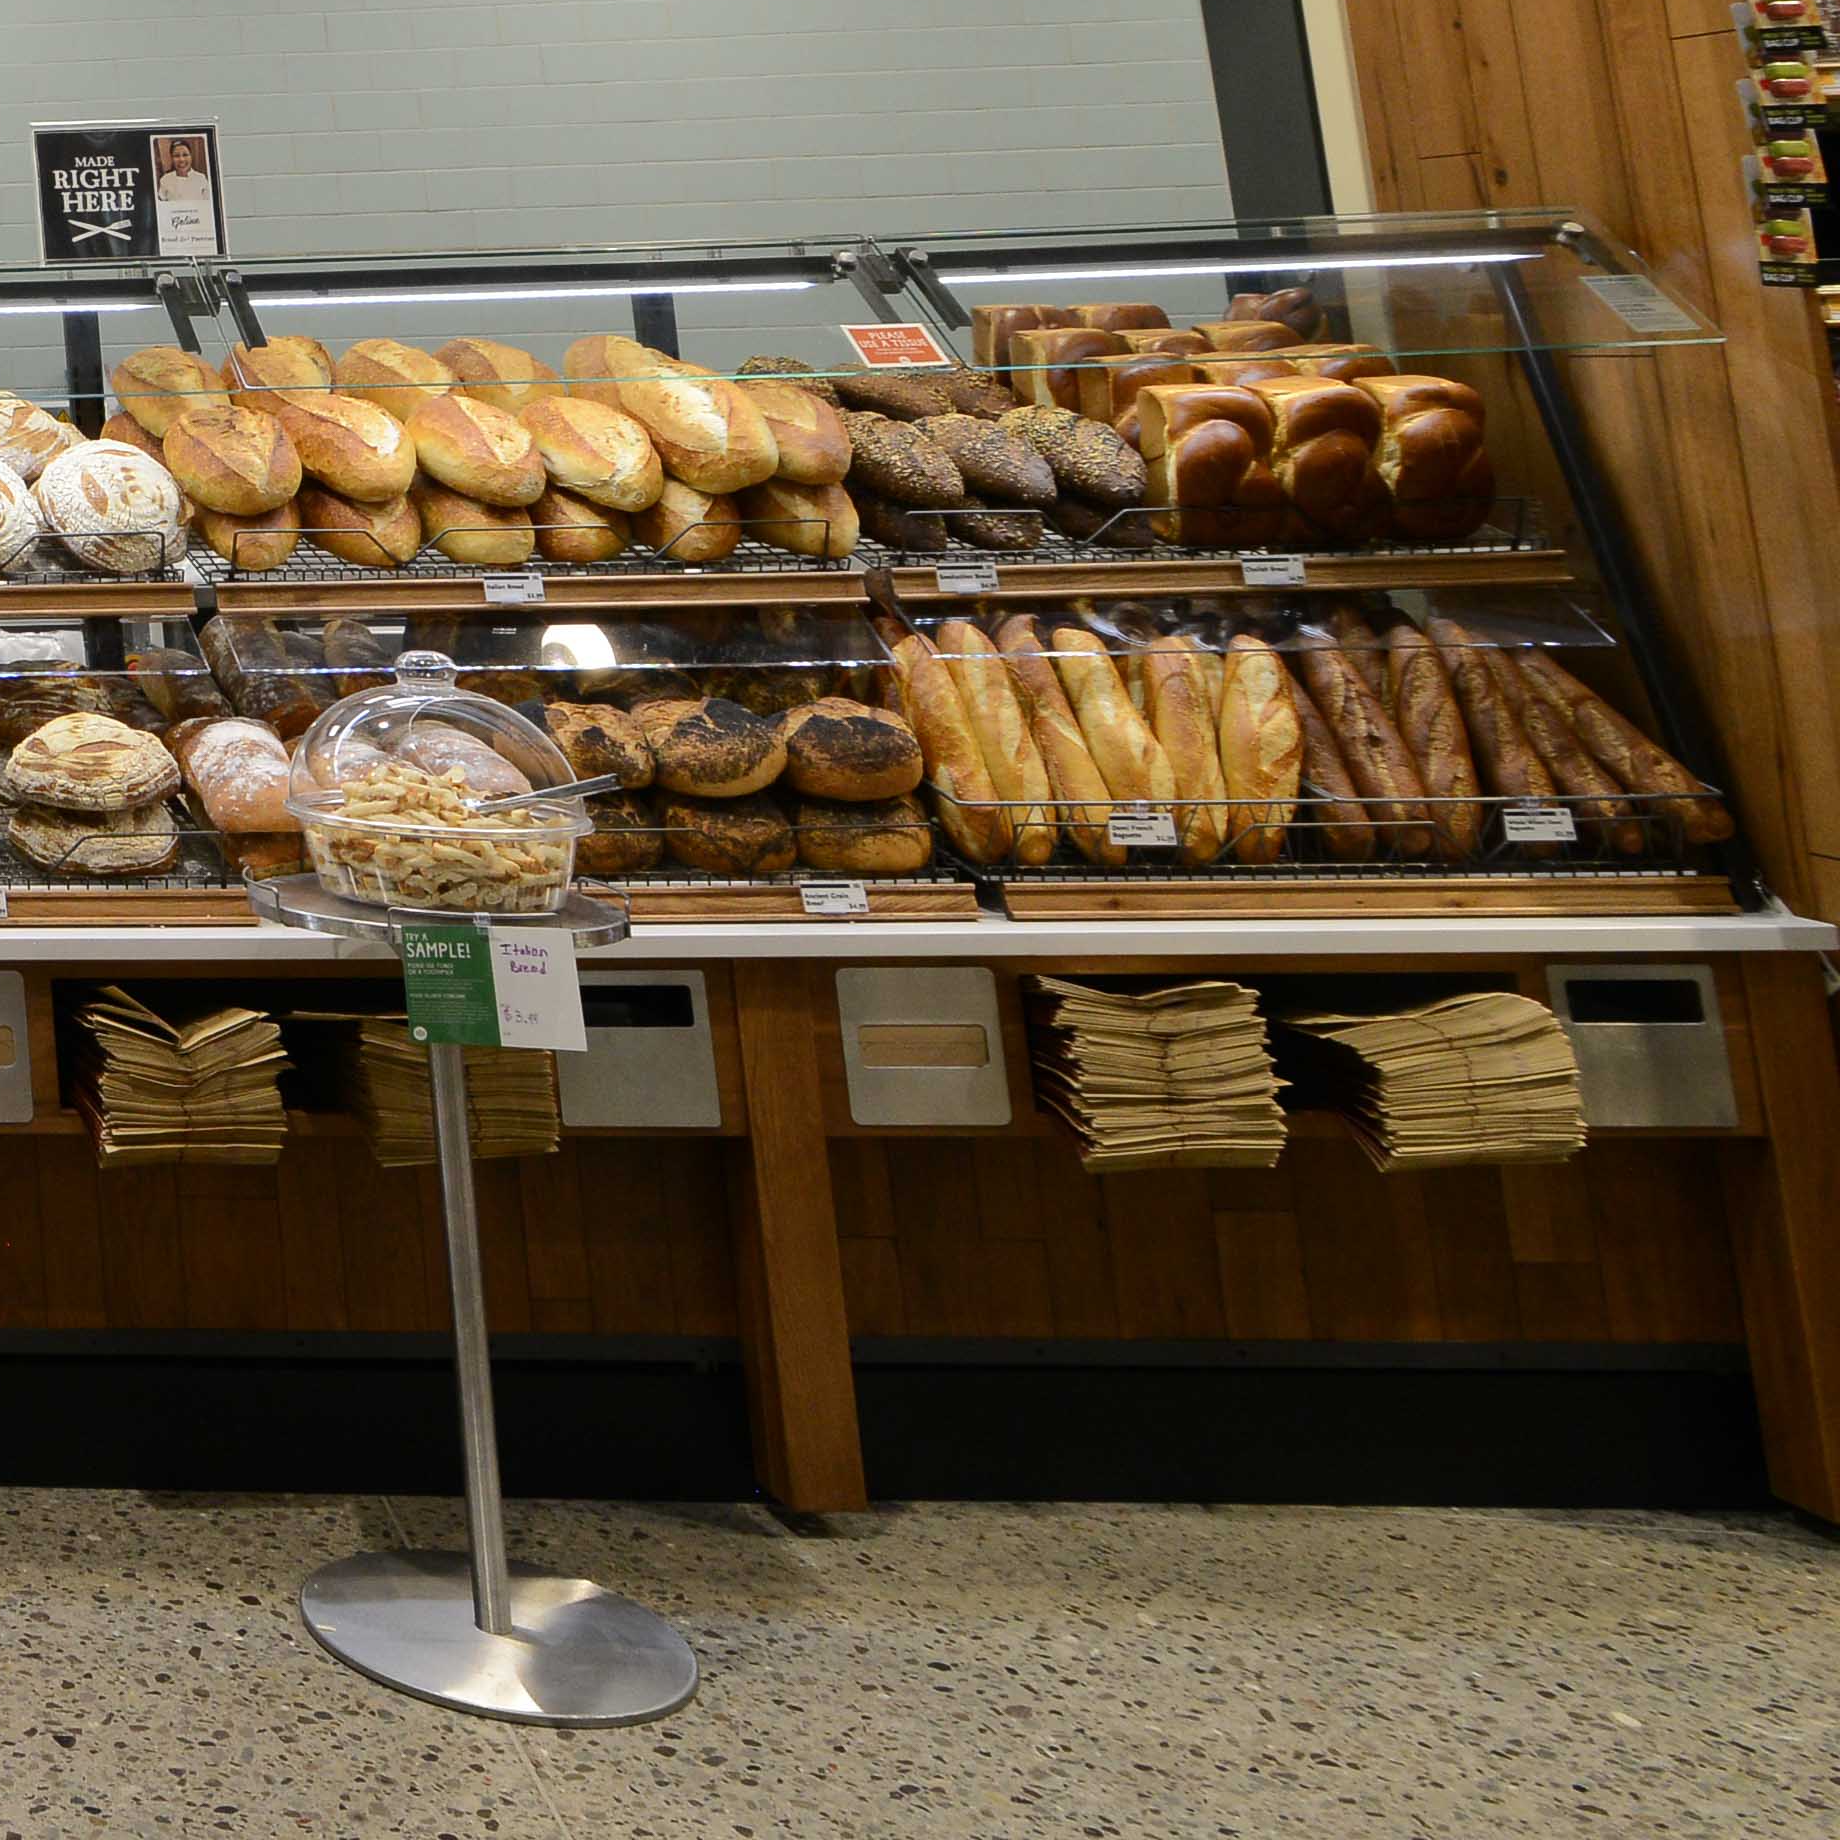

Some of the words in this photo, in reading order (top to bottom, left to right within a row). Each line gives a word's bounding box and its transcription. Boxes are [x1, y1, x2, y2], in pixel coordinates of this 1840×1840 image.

[75, 156, 115, 167] MADE
[52, 168, 139, 189] RIGHT
[61, 190, 134, 213] HERE
[406, 943, 471, 959] SAMPLE!
